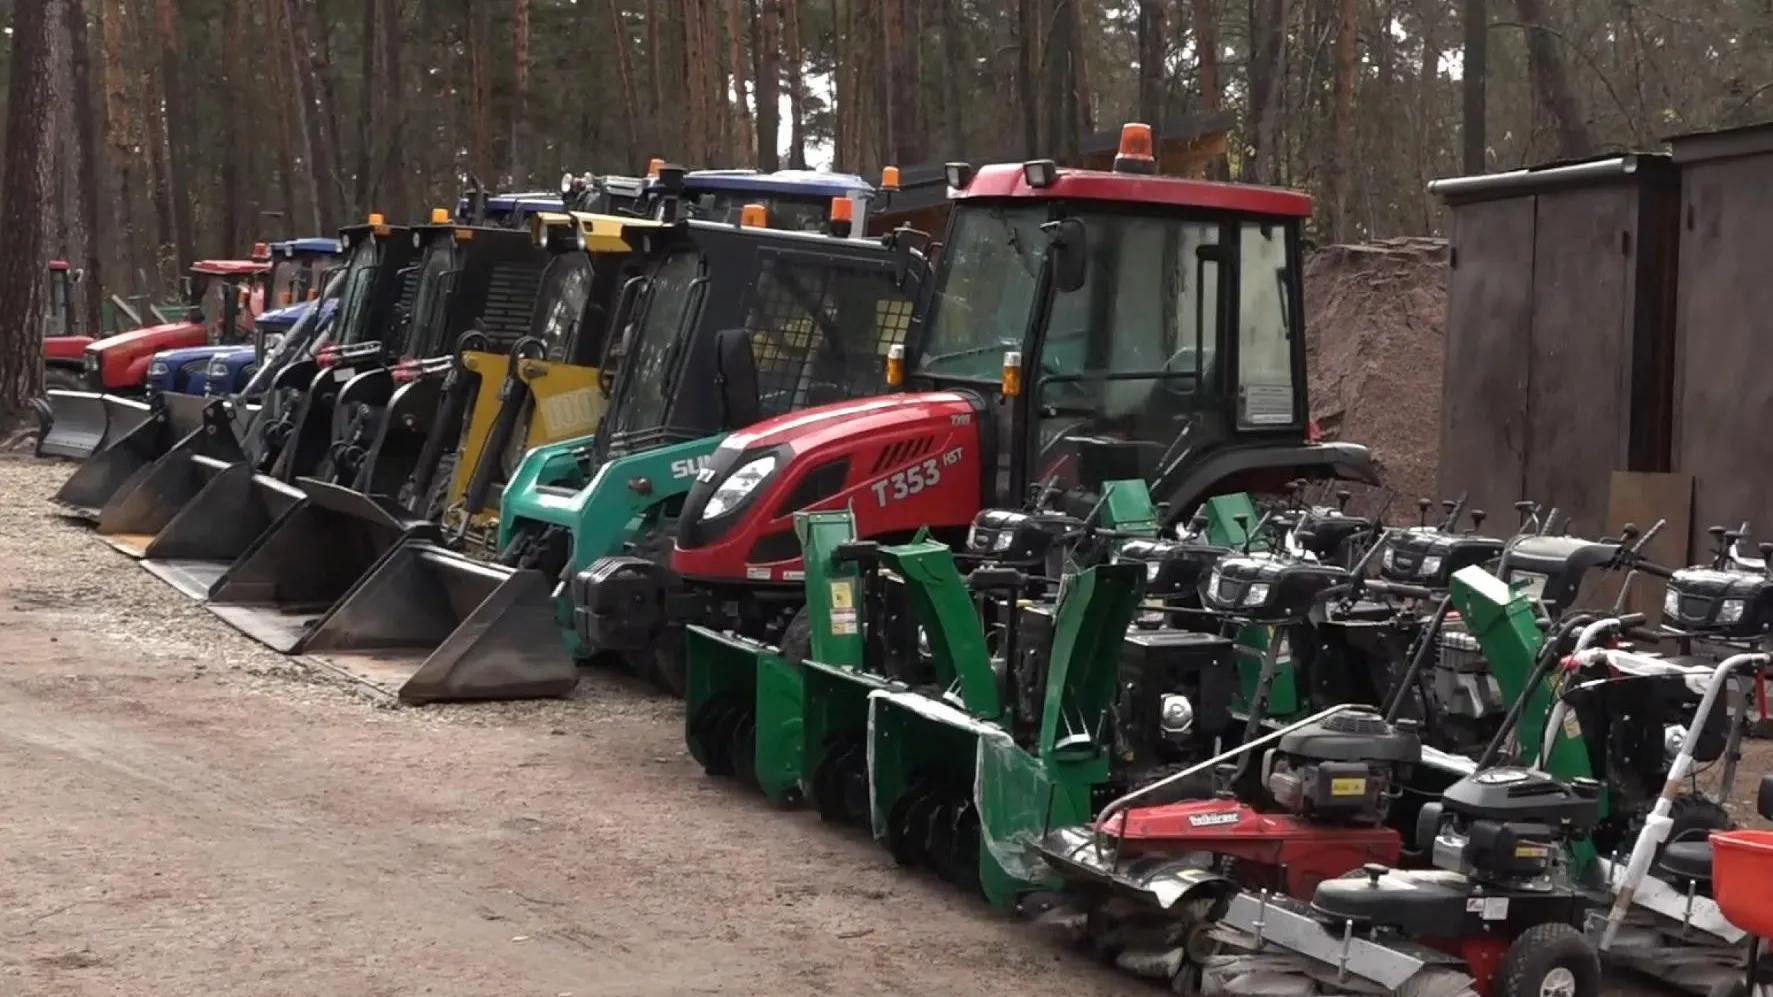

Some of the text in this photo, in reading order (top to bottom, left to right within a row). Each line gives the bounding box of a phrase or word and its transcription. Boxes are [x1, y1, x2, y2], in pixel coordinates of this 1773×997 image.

[671, 454, 712, 479] SU
[871, 447, 963, 508] T353 HST
